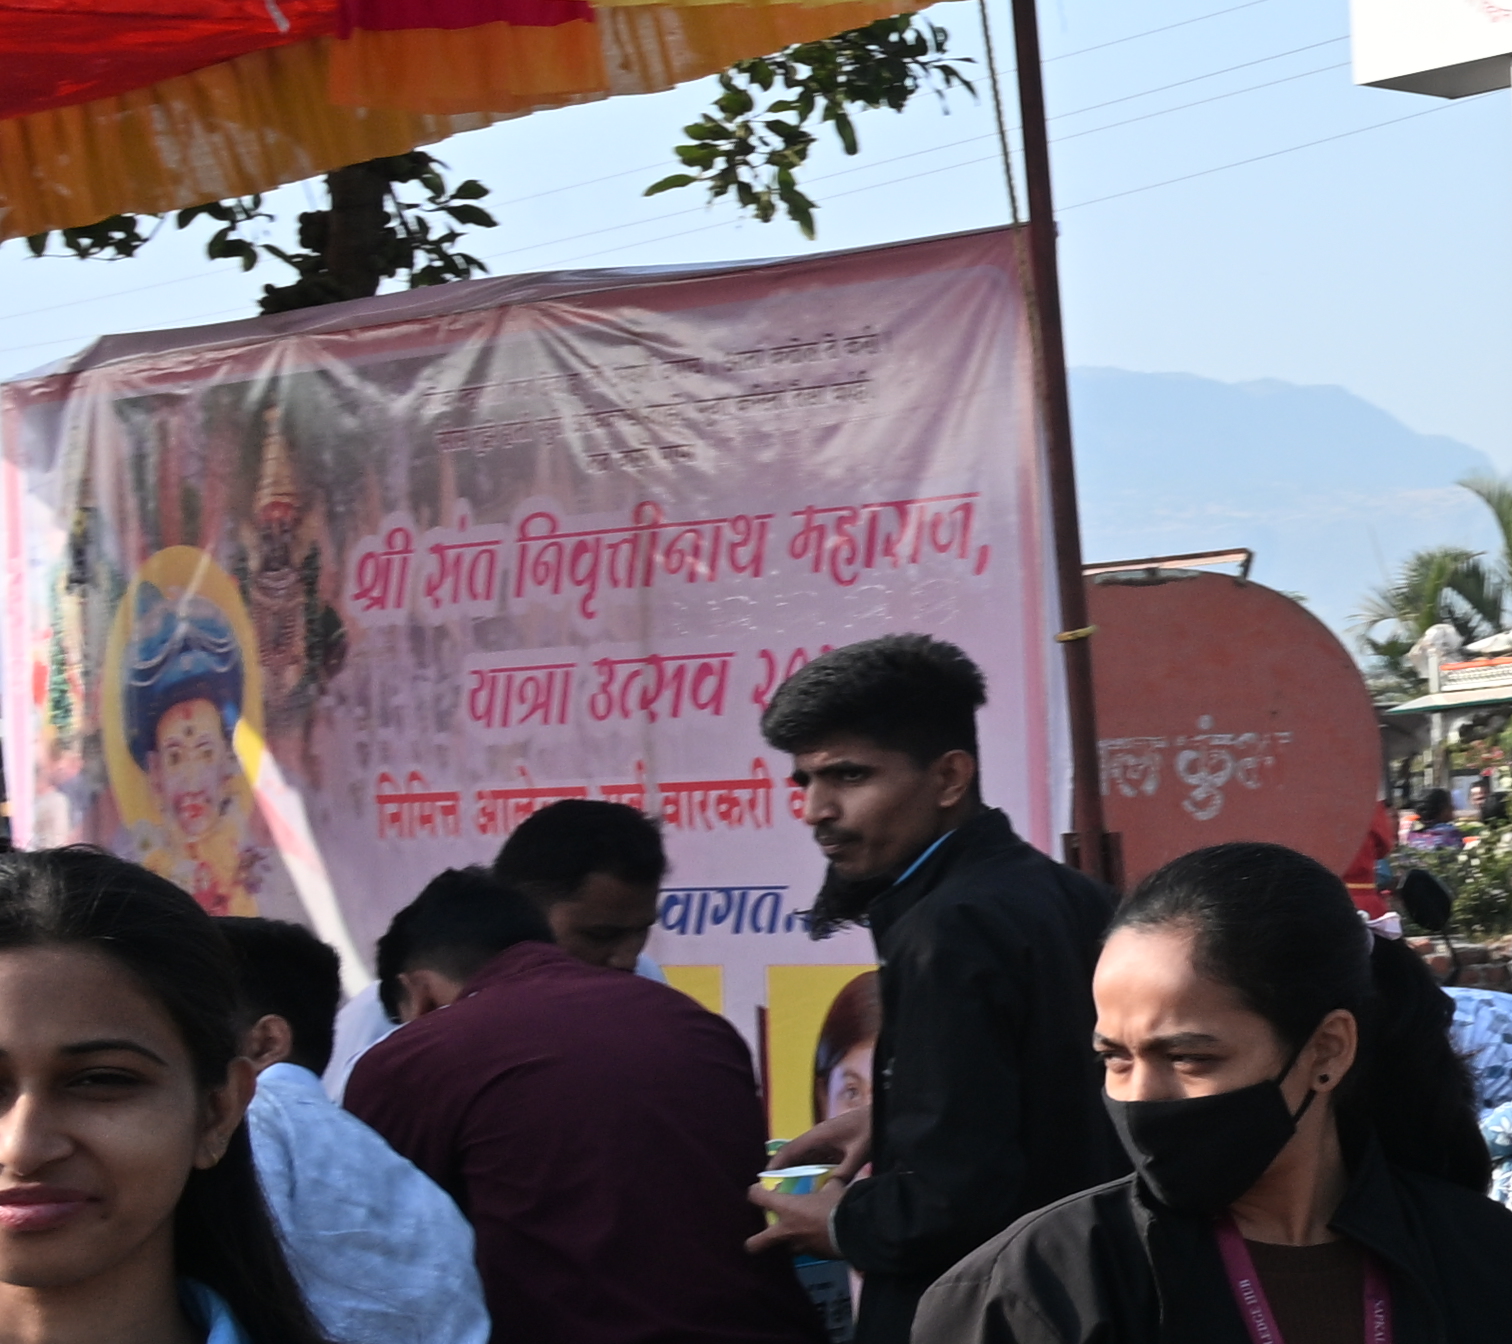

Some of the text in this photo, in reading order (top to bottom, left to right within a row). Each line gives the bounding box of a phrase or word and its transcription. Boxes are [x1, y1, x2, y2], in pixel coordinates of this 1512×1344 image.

[351, 490, 993, 620] श्री संत निवृत्तीनाथ महाराज,
[468, 661, 578, 729] यात्रा
[588, 650, 738, 724] उत्सव
[374, 769, 463, 839] निमित्त
[657, 755, 774, 832] वारकरी
[1238, 1278, 1259, 1306] HUB
[1373, 1299, 1387, 1343] SAPKAL
